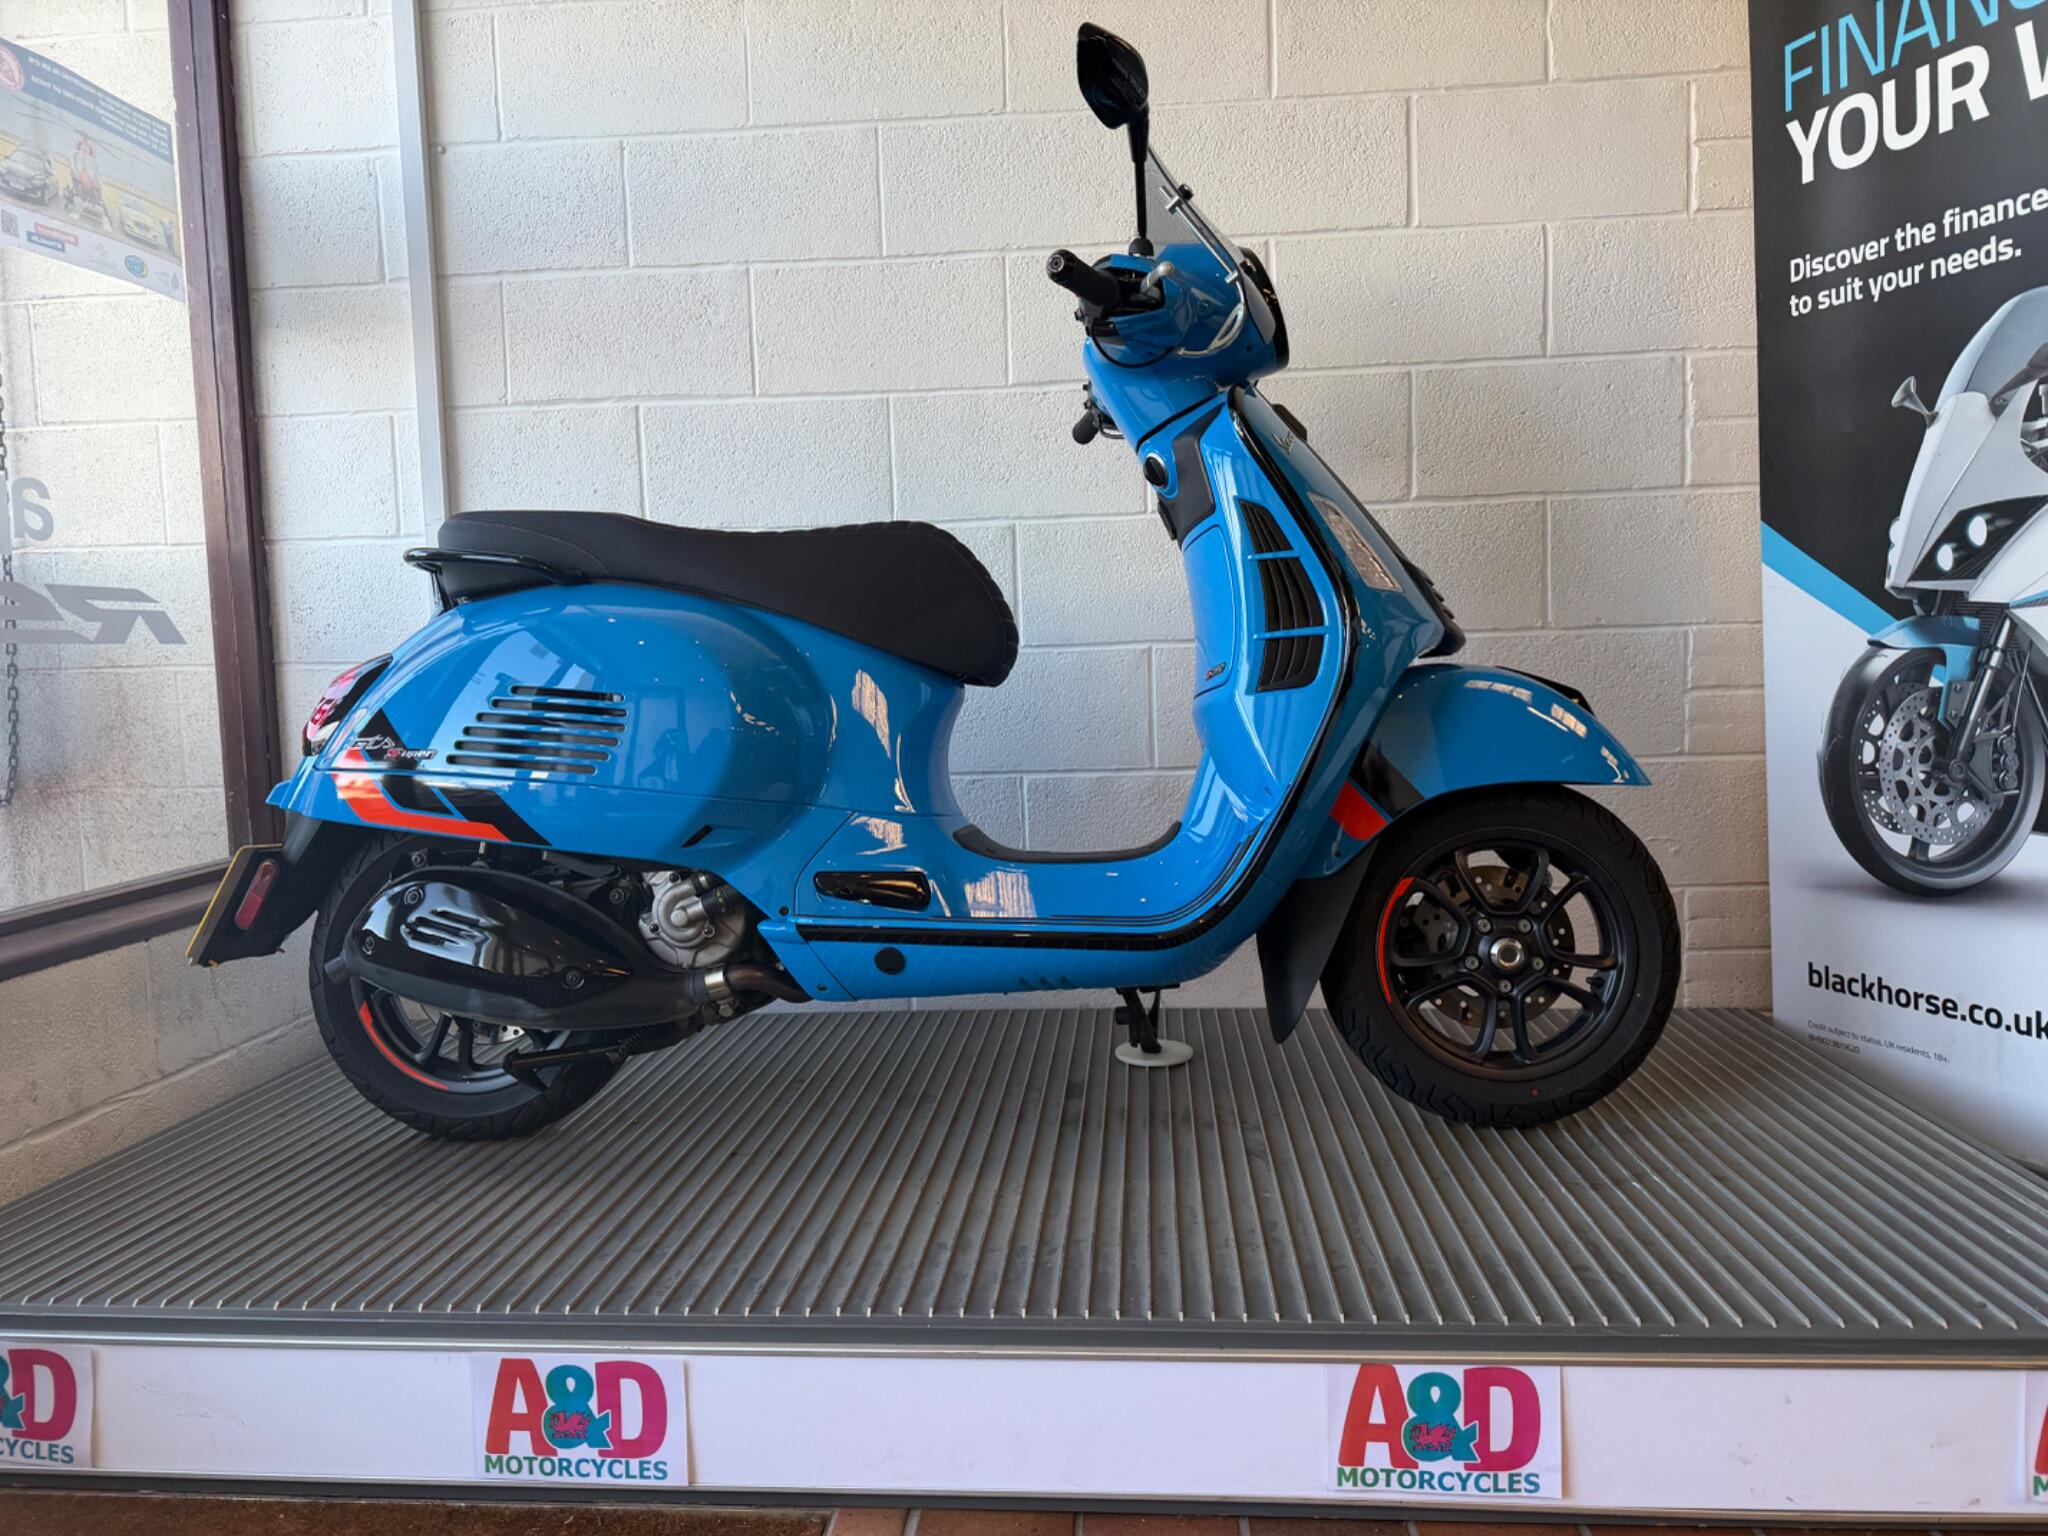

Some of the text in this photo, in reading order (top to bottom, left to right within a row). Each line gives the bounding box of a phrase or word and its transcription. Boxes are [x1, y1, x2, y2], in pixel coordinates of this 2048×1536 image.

[1786, 45, 1990, 184] YOUR
[1790, 188, 2048, 283] Discover the finance
[1790, 235, 2022, 317] to suit your needs.
[1808, 962, 2048, 1039] blackhorse.co.uk
[486, 1358, 668, 1459] A&D
[1338, 1363, 1541, 1472] A&D
[485, 1455, 668, 1481] MOTORCYCLES
[1337, 1467, 1541, 1494] MOTORCYCLES
